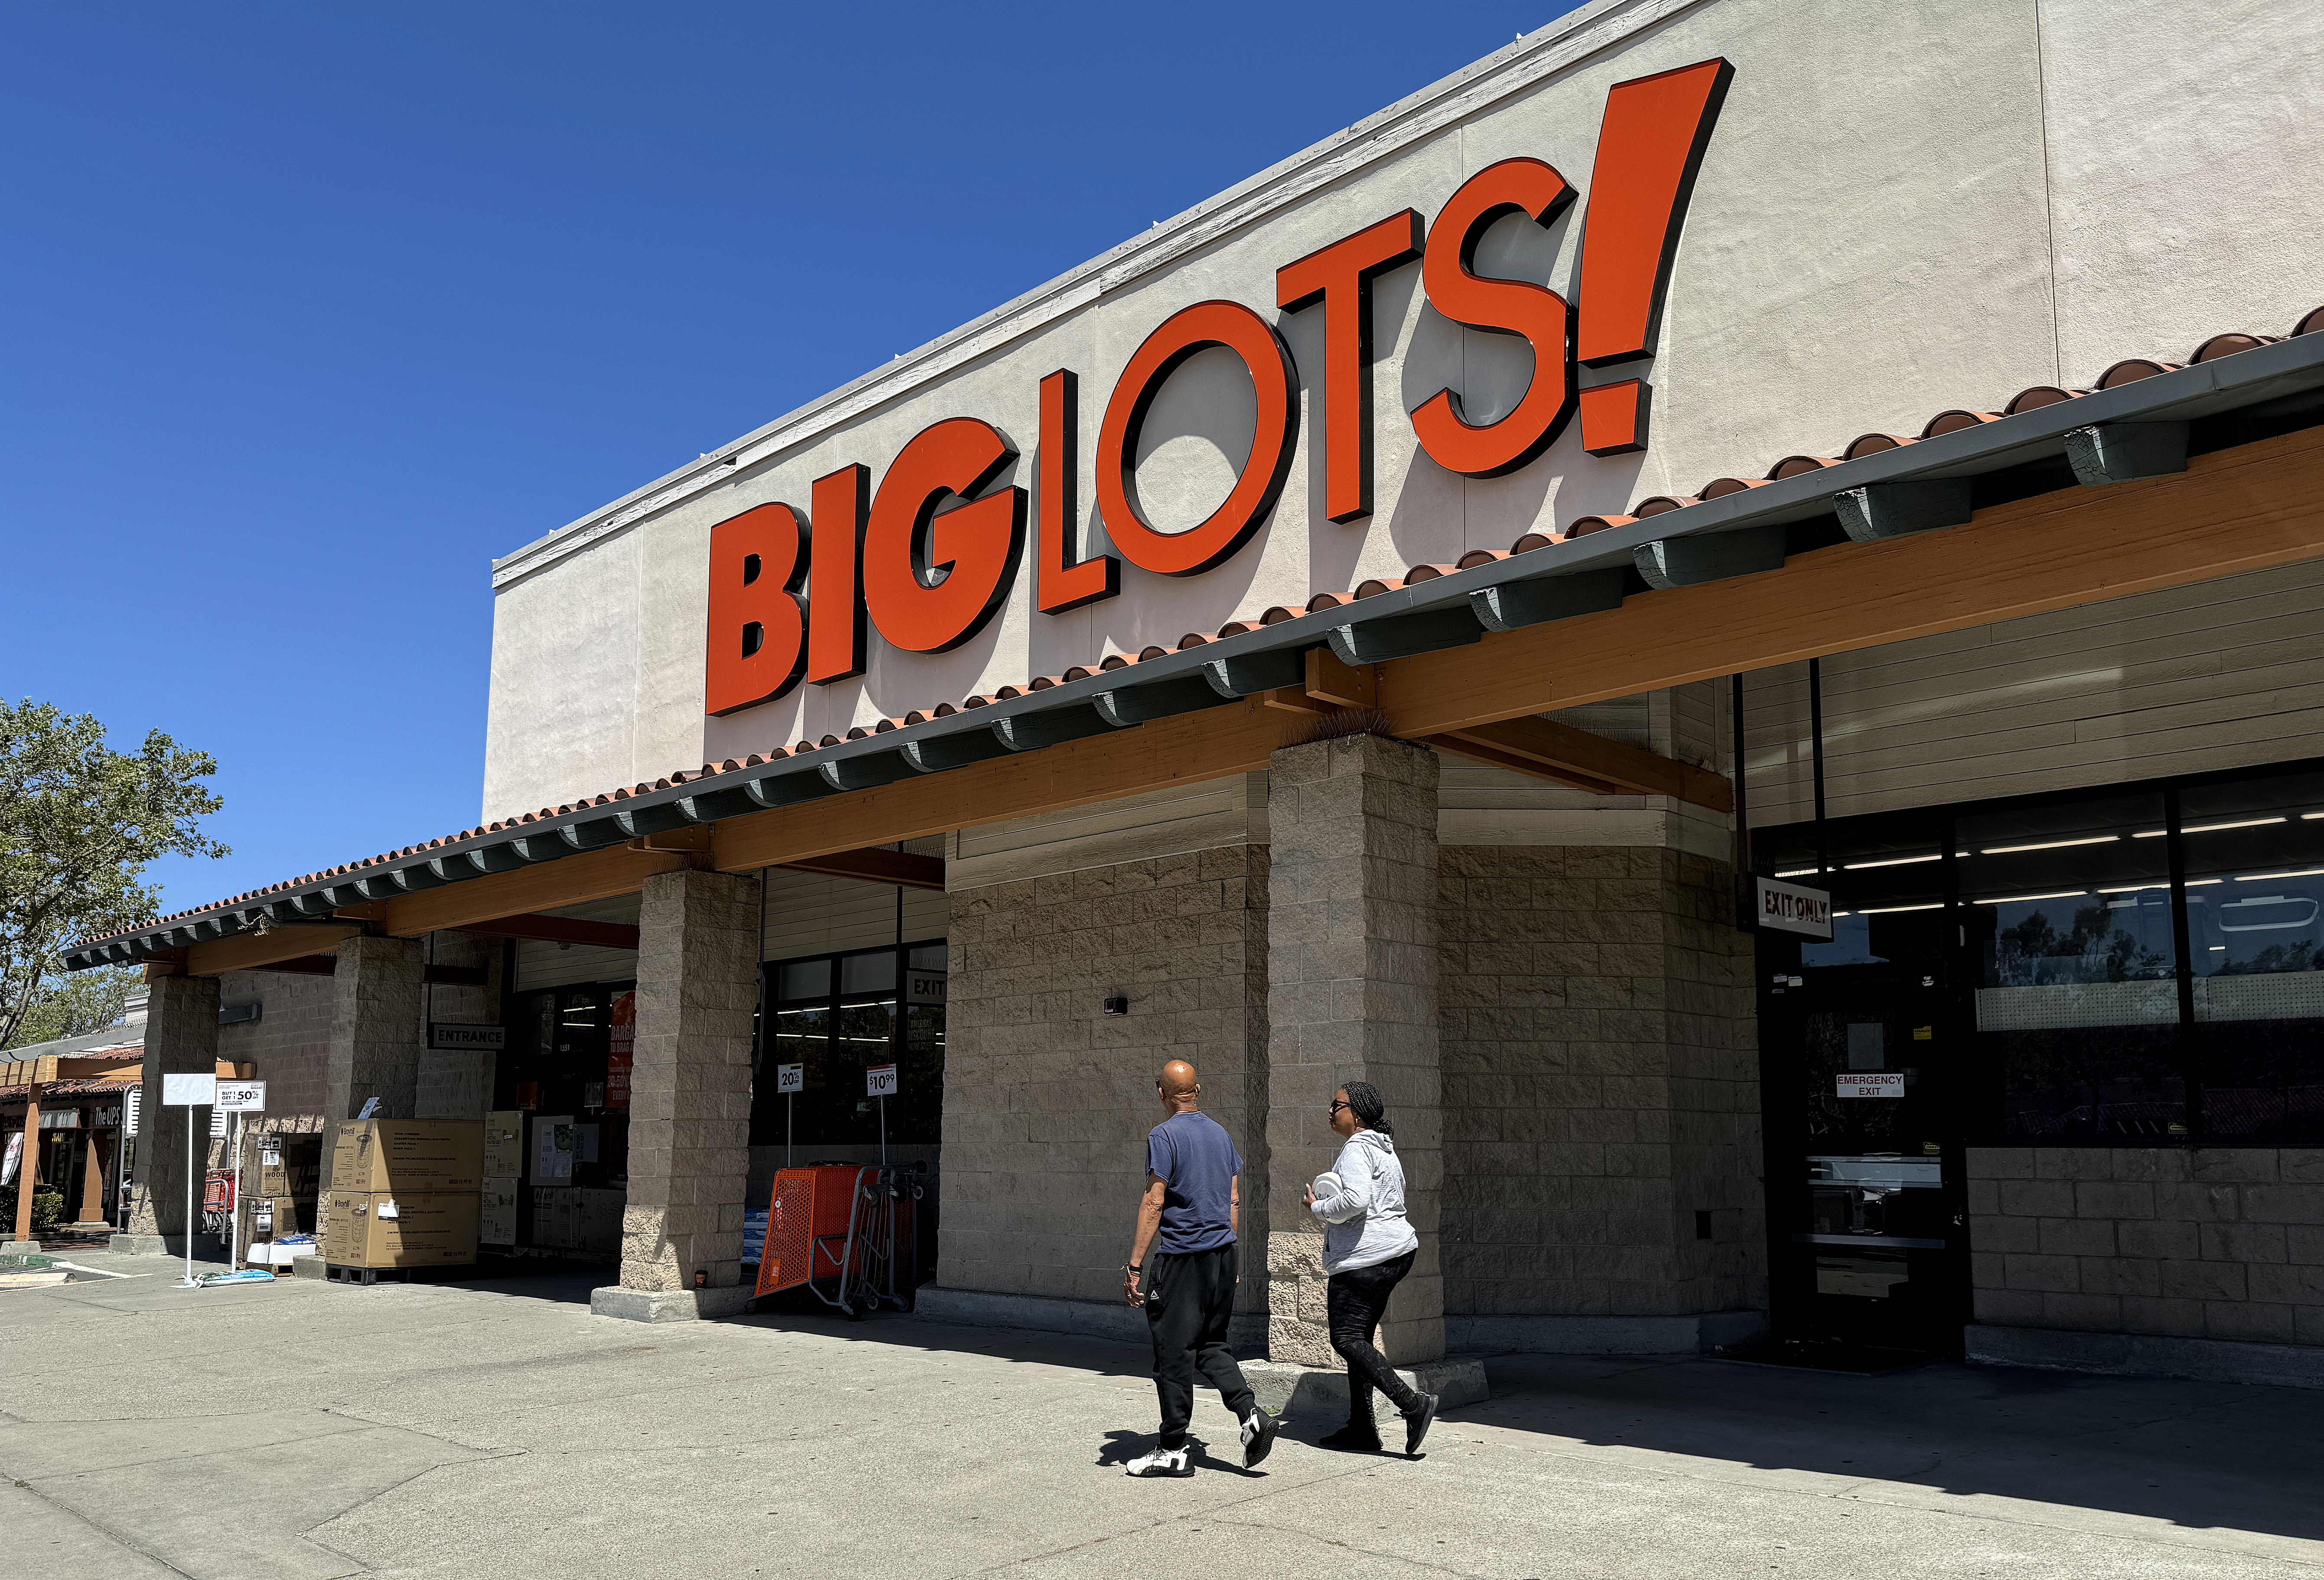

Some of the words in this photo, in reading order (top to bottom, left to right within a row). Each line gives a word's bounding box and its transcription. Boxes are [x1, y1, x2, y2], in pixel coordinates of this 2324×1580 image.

[705, 417, 1029, 718] BIG
[1038, 57, 1736, 615] LOTS!
[1765, 890, 1793, 917] EXIT
[1796, 897, 1827, 924] ONLY
[914, 979, 945, 996] EXIT
[438, 1030, 502, 1043] ENTRANCE
[610, 1042, 616, 1052] TO
[96, 1107, 106, 1125] The
[107, 1106, 121, 1125] UPS
